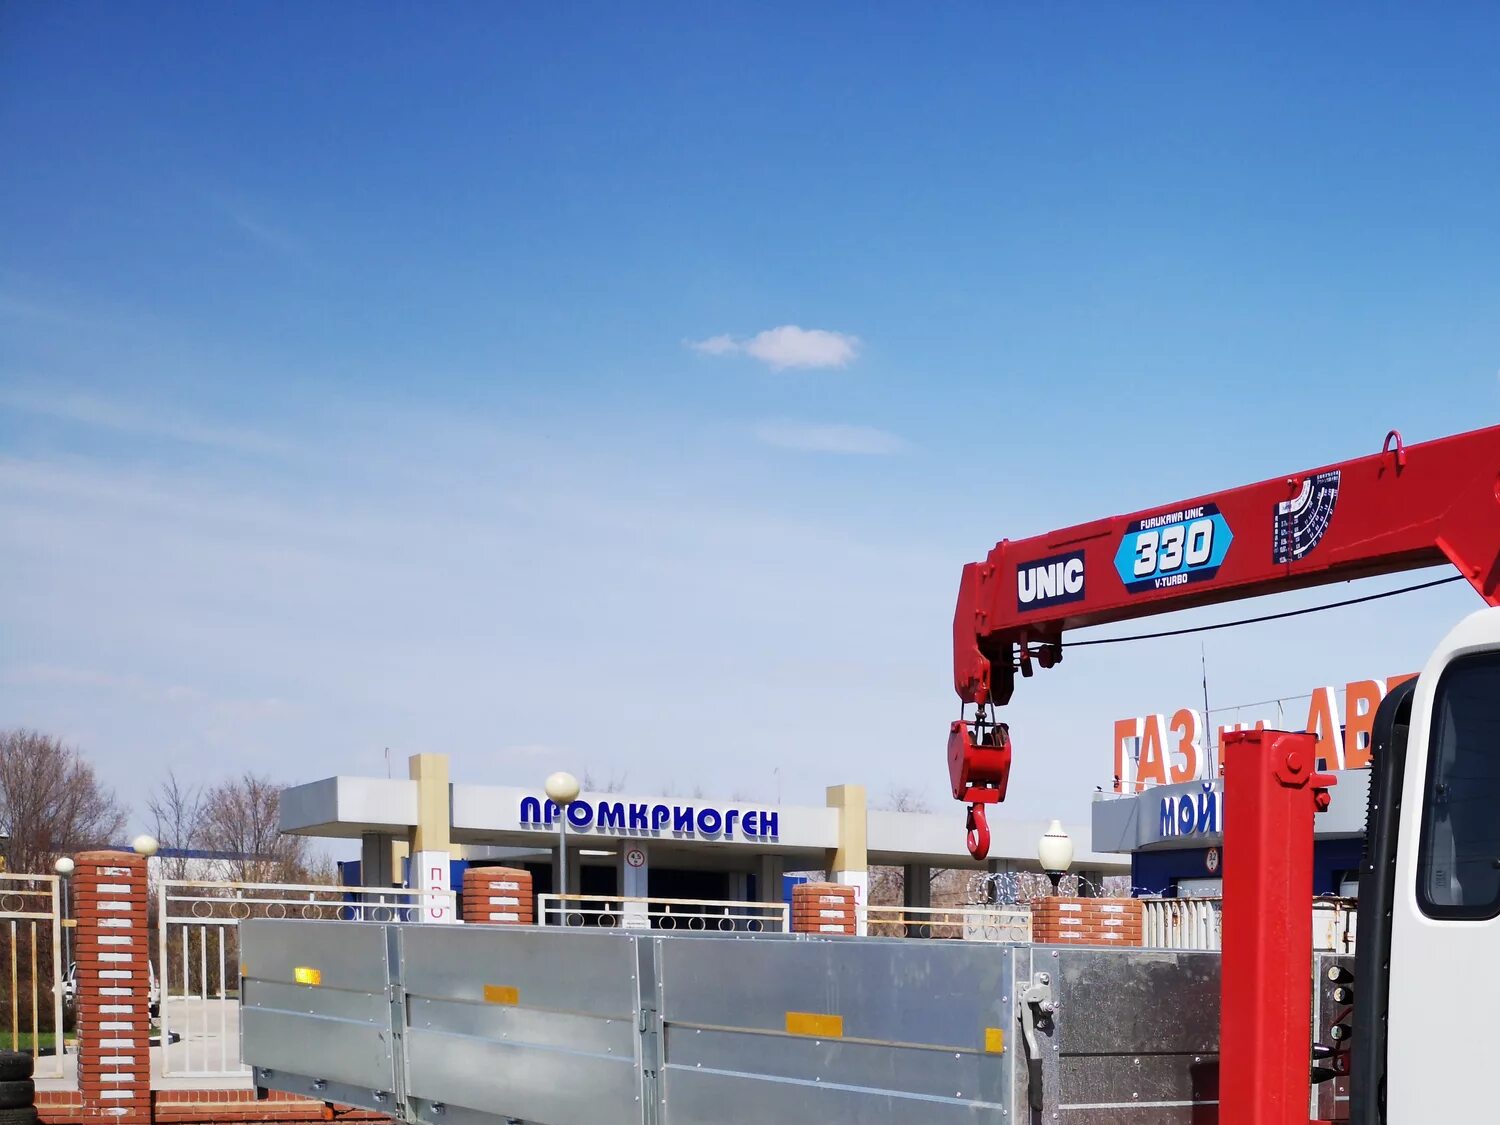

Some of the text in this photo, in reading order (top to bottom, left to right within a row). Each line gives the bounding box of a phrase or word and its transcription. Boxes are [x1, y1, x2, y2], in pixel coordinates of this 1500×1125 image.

[1140, 506, 1204, 530] FURUKAWA UNIC
[1133, 518, 1214, 577] 330
[1017, 558, 1084, 603] UNIC
[1154, 573, 1188, 589] V-TURBO
[1113, 708, 1200, 793] ГАЗ
[1306, 672, 1421, 770] АВ
[520, 796, 779, 837] ПРОМКРИОГЕН
[1160, 783, 1223, 836] МОЙ
